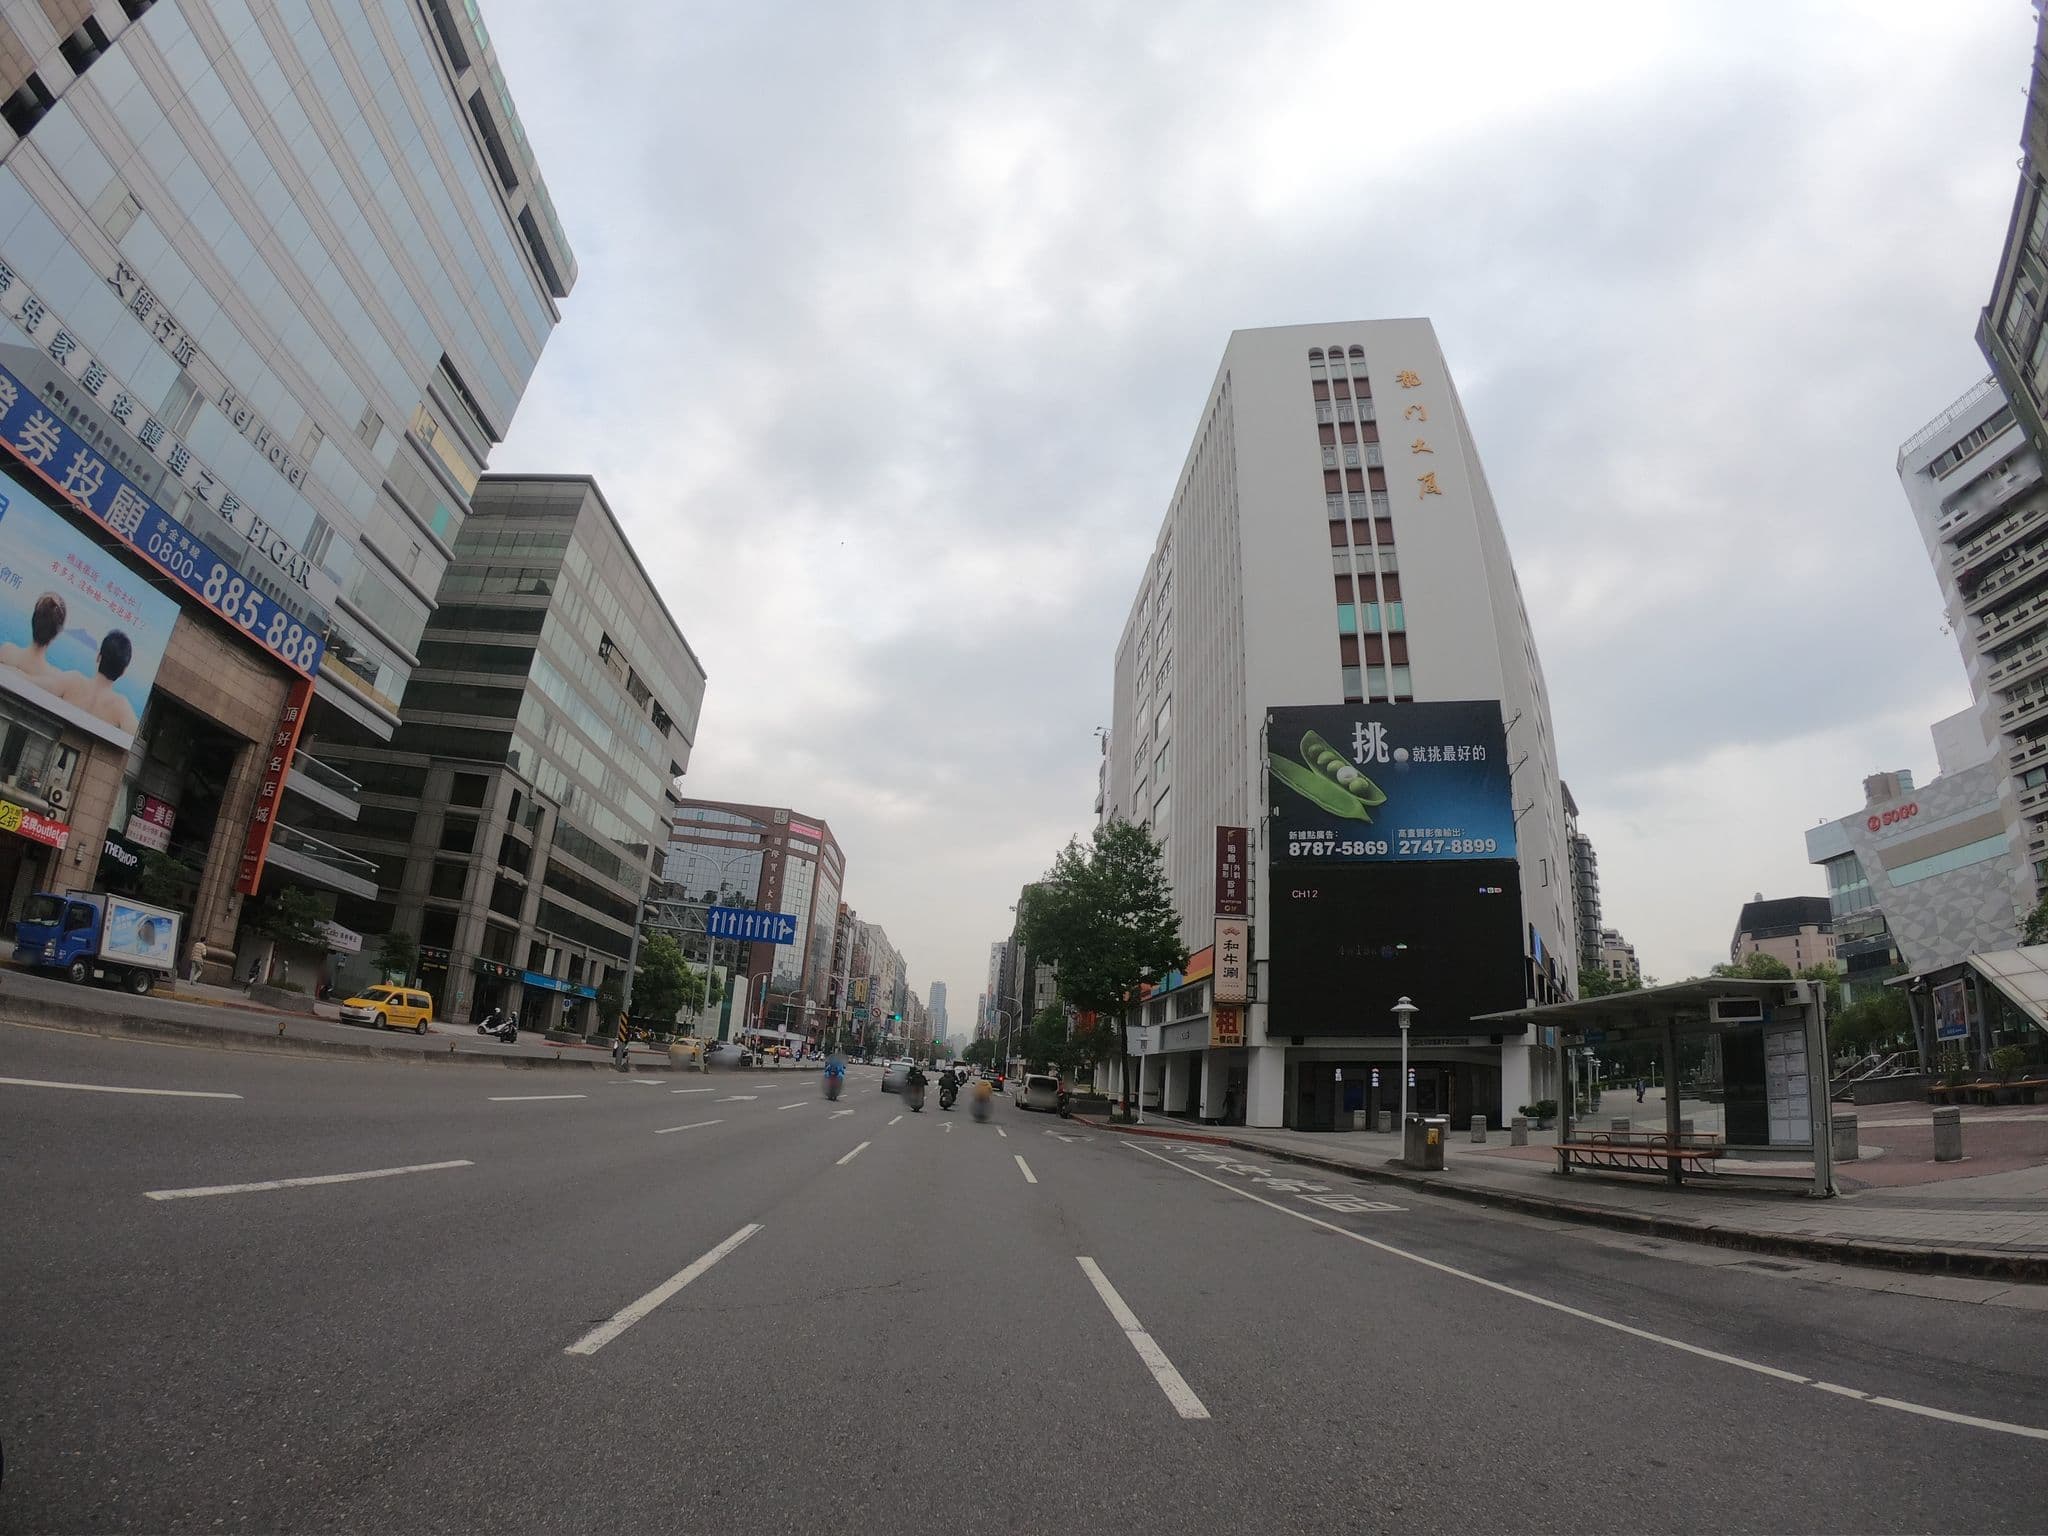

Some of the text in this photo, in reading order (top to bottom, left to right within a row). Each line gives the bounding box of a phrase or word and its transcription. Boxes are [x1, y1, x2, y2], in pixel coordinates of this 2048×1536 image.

[254, 425, 307, 490] Hotel
[246, 517, 311, 590] ELGAR
[148, 533, 317, 672] 0800-885-888
[1352, 721, 1390, 764] 挑
[1412, 744, 1487, 763] 就挑最好的
[255, 706, 299, 823] 頂好名店城
[1882, 802, 1918, 826] SOGO
[1288, 840, 1388, 857] 8787-5869
[1399, 838, 1497, 855] 2747-8899
[1291, 889, 1319, 899] CH12
[1223, 940, 1240, 979] 和牛涮
[1215, 1007, 1239, 1034] 租
